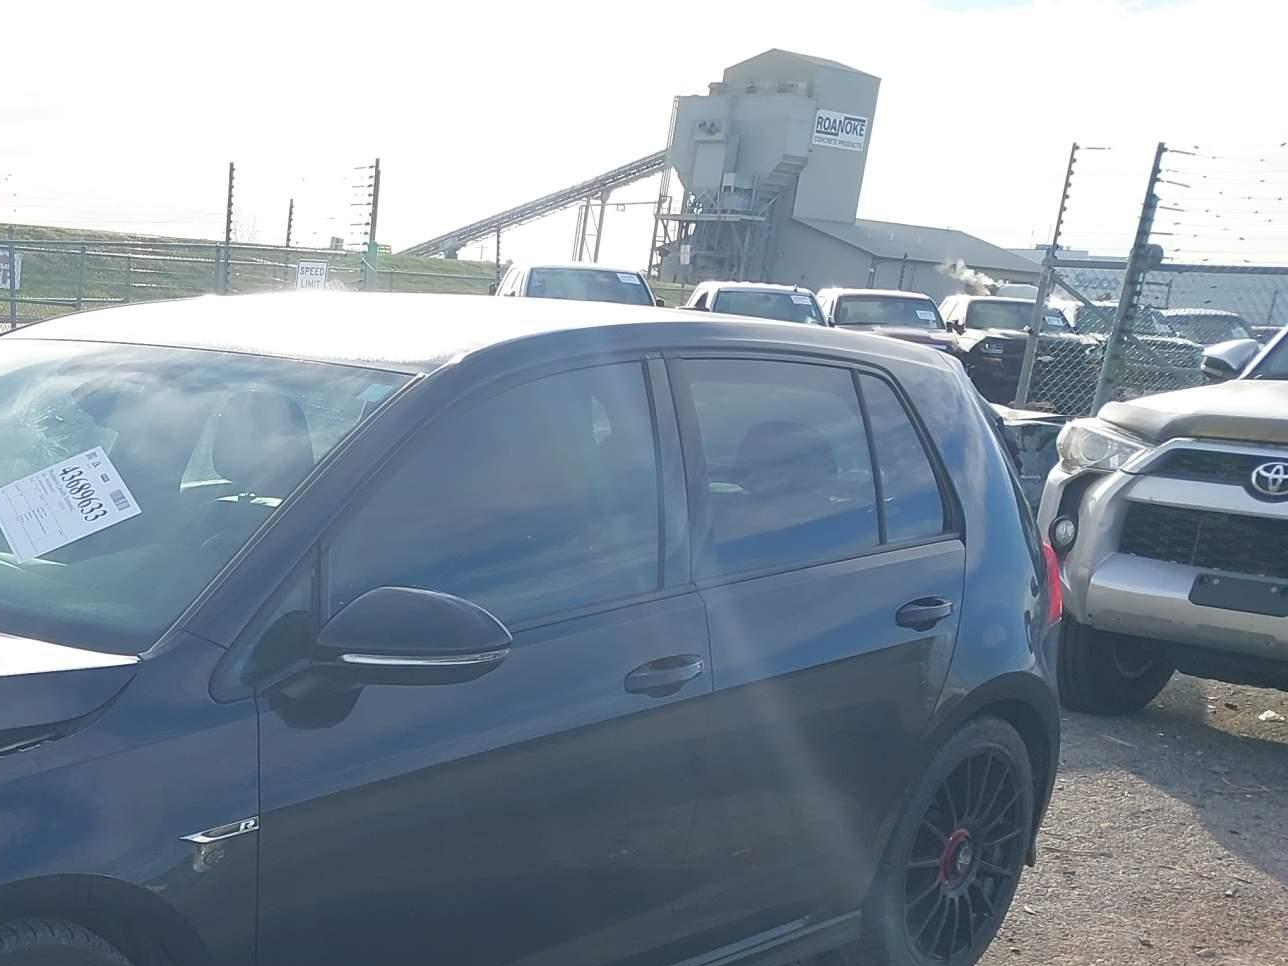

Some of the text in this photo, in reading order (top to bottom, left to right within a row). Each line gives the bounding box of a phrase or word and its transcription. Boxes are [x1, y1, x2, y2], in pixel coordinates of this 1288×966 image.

[816, 115, 866, 137] ROANOKE
[814, 136, 838, 146] CONCRETE
[300, 266, 325, 276] SPEED
[300, 279, 321, 288] LIMIT
[60, 466, 108, 522] 43689633
